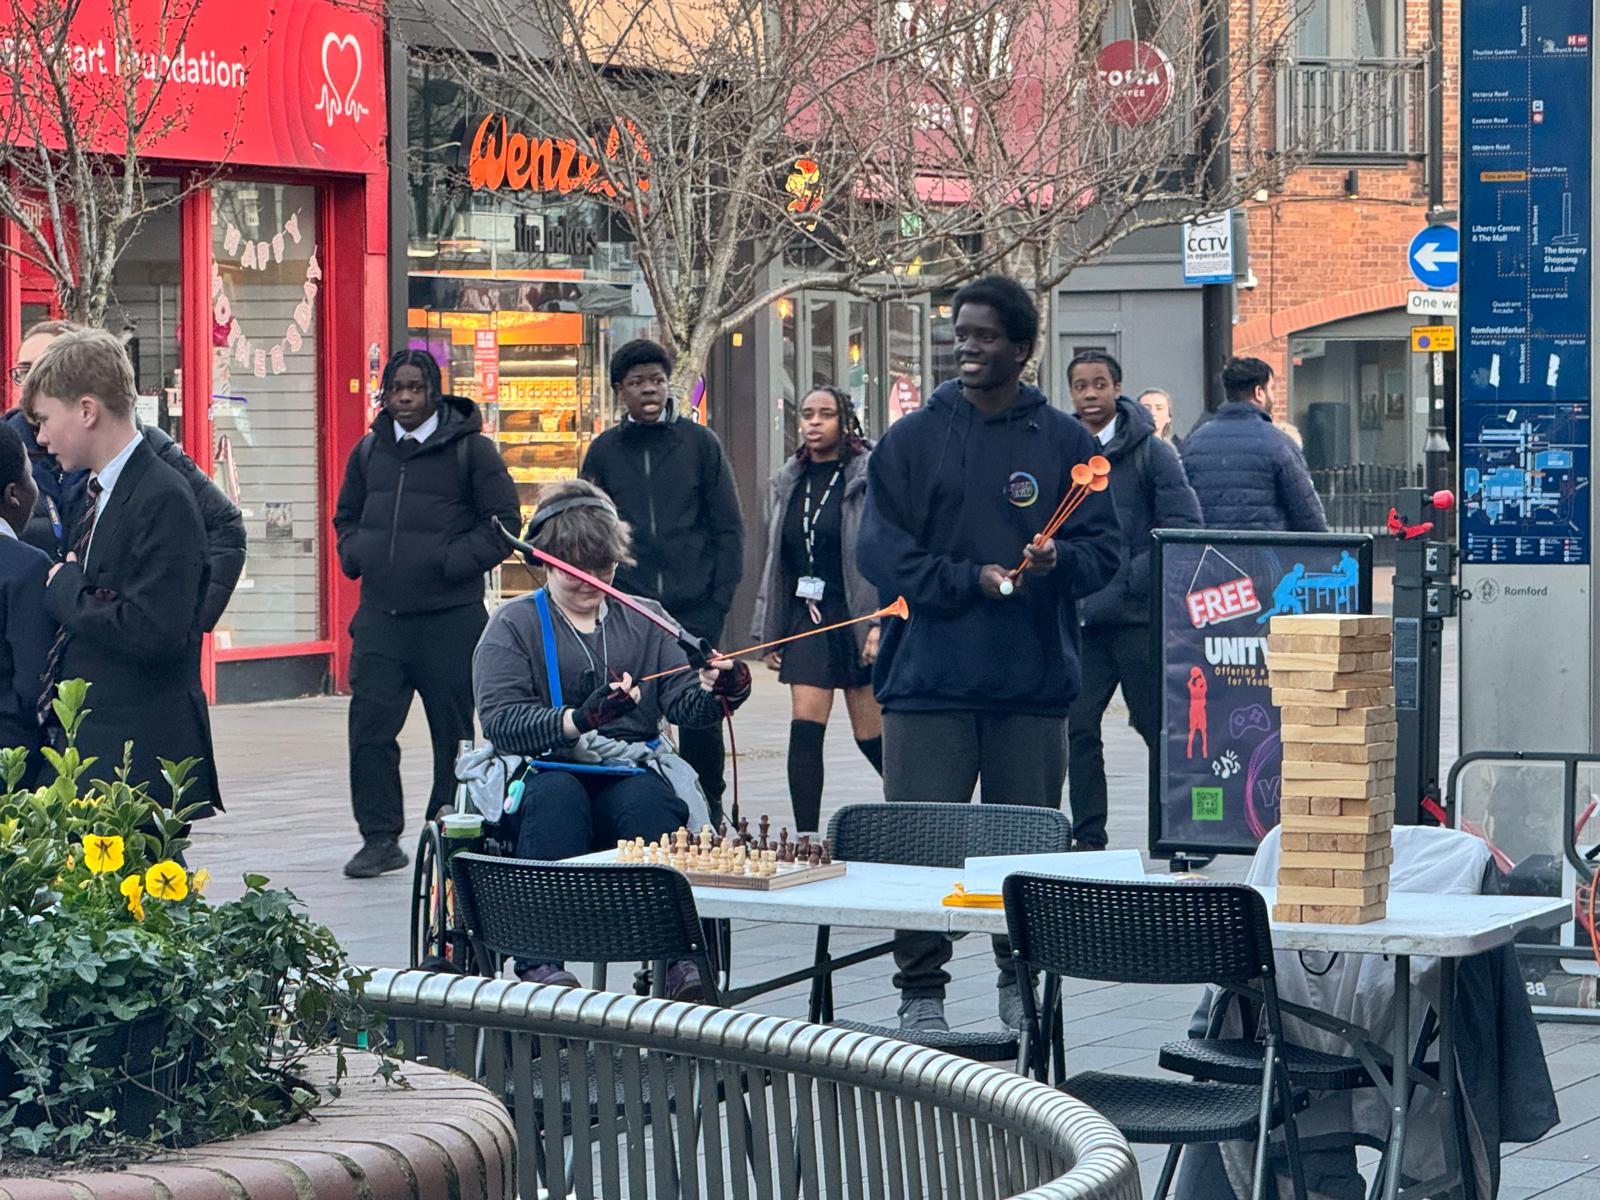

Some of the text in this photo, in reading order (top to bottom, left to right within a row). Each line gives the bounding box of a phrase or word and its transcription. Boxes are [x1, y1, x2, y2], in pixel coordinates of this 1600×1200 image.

[115, 38, 246, 88] Fundation
[514, 215, 541, 252] the
[1471, 224, 1521, 234] Liberty Centre
[1478, 234, 1492, 242] The
[1492, 234, 1508, 242] Mall
[1187, 236, 1228, 252] CCTV
[1195, 251, 1230, 260] operation
[1543, 246, 1588, 255] The Brewery
[1543, 255, 1579, 265] Shopping
[1550, 265, 1577, 273] Leisure
[1412, 295, 1458, 310] One wa
[1470, 326, 1526, 334] Romford Market
[1504, 585, 1548, 597] Romford
[1189, 579, 1257, 624] FREE
[1214, 666, 1256, 677] Offering
[1228, 676, 1269, 687] for Youn
